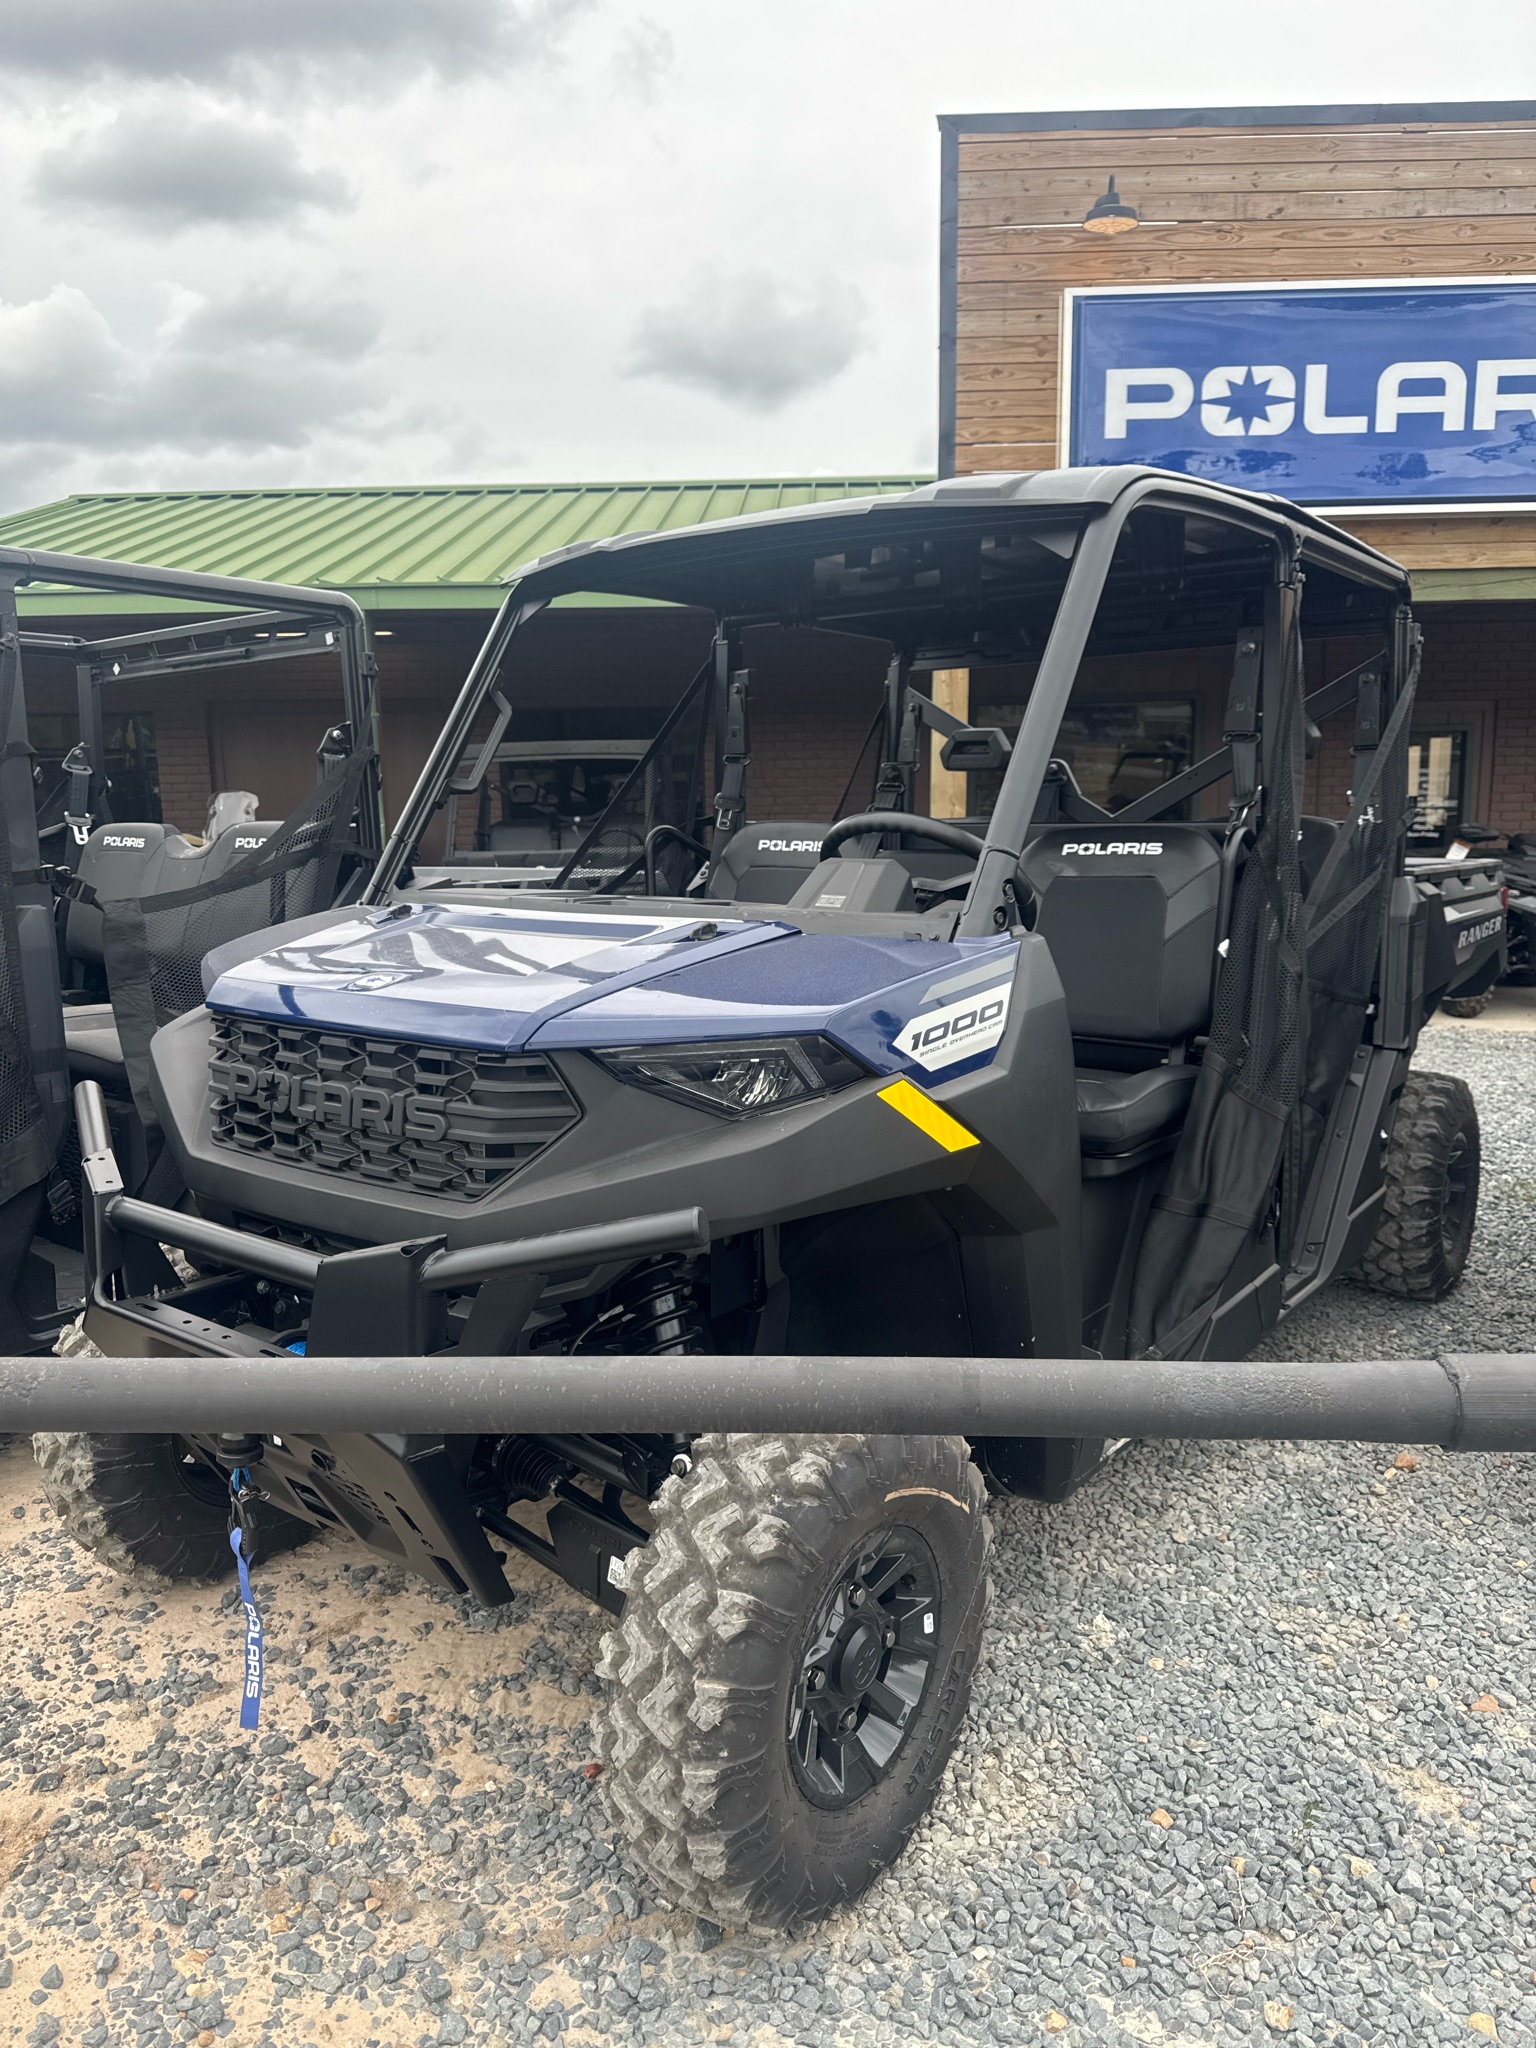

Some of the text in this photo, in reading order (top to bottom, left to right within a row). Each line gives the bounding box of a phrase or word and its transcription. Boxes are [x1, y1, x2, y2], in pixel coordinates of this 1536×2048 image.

[1104, 358, 1536, 439] POLAR
[103, 836, 146, 849] POLARIS
[1061, 842, 1163, 855] POLARIS
[1457, 915, 1502, 949] RANGER
[911, 999, 1004, 1052] 1000
[919, 1019, 1003, 1057] SINGLE OVERHEAD CAM
[228, 1063, 449, 1142] POLARIS
[244, 1602, 261, 1699] POLARIS
